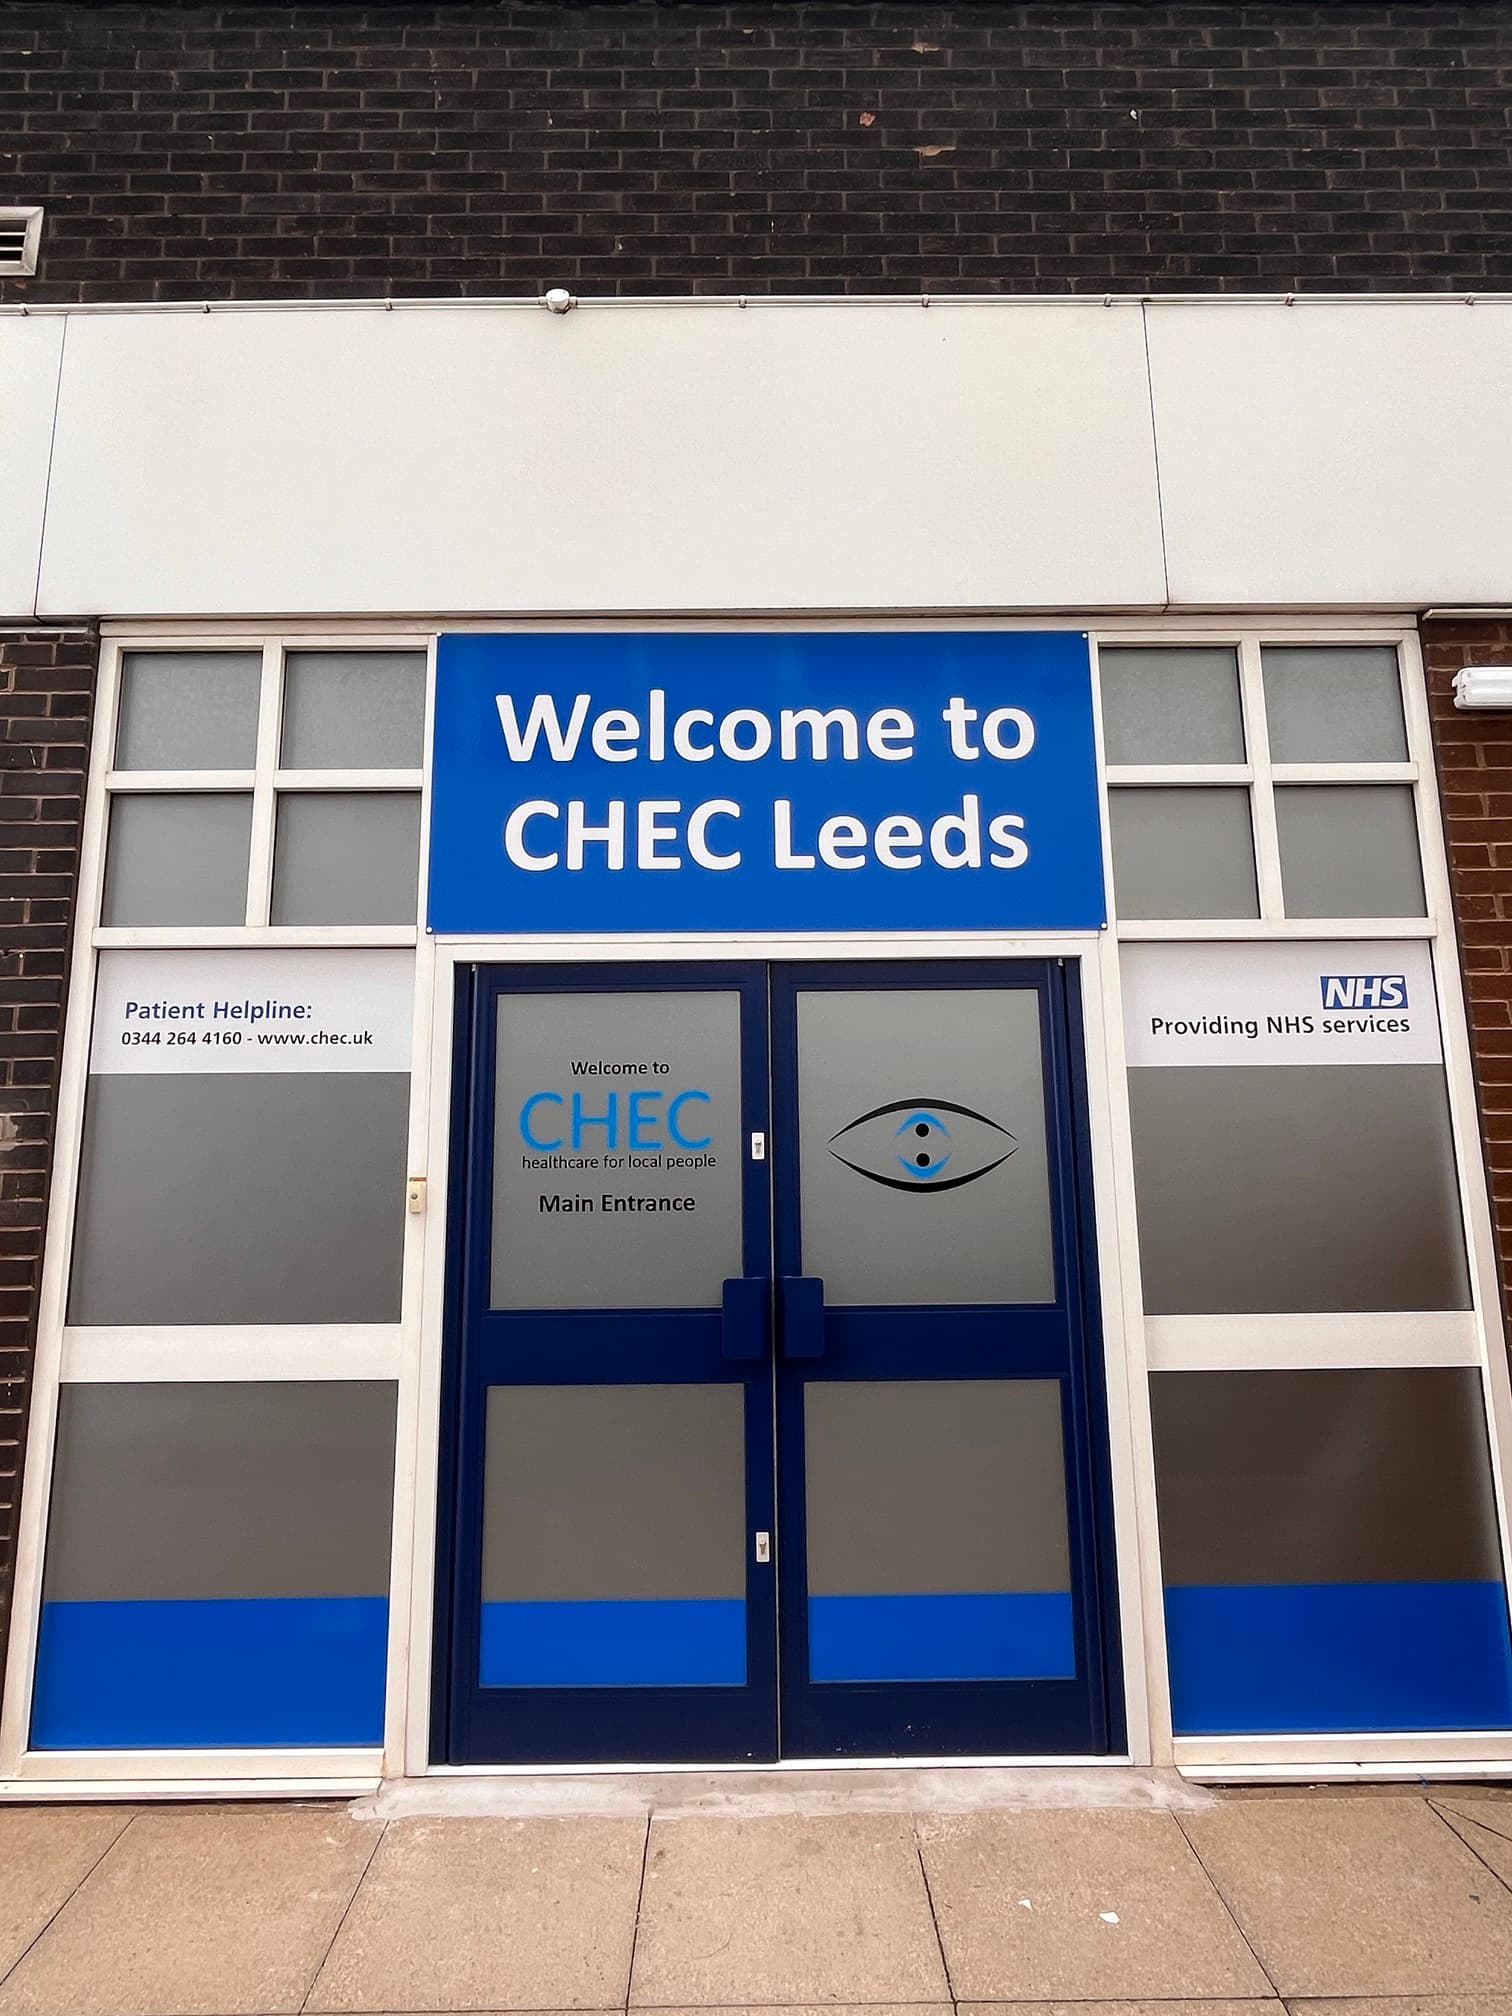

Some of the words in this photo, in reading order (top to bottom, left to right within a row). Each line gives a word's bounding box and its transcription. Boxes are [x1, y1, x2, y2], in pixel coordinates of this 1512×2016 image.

[496, 690, 914, 761] Welcome
[943, 698, 1034, 759] to
[506, 800, 740, 870] CHEC
[775, 795, 1028, 869] Leeds
[1325, 977, 1404, 1007] NHS
[126, 1000, 205, 1019] Patient
[214, 1000, 311, 1024] Helpline:
[122, 1031, 161, 1046] 0344
[167, 1031, 196, 1046] 264
[202, 1031, 241, 1045] 4160
[258, 1030, 372, 1045] www.chec.uk
[1152, 1015, 1257, 1039] Providing
[1267, 1015, 1314, 1034] NHS
[1323, 1014, 1409, 1034] services
[570, 1060, 648, 1076] Welcome
[653, 1061, 669, 1074] to
[520, 1091, 711, 1150] CHEC
[523, 1155, 599, 1169] healthcare
[604, 1154, 624, 1170] for
[628, 1154, 662, 1169] local
[666, 1153, 716, 1171] people
[540, 1193, 593, 1213] Main
[601, 1194, 695, 1212] Entrance
